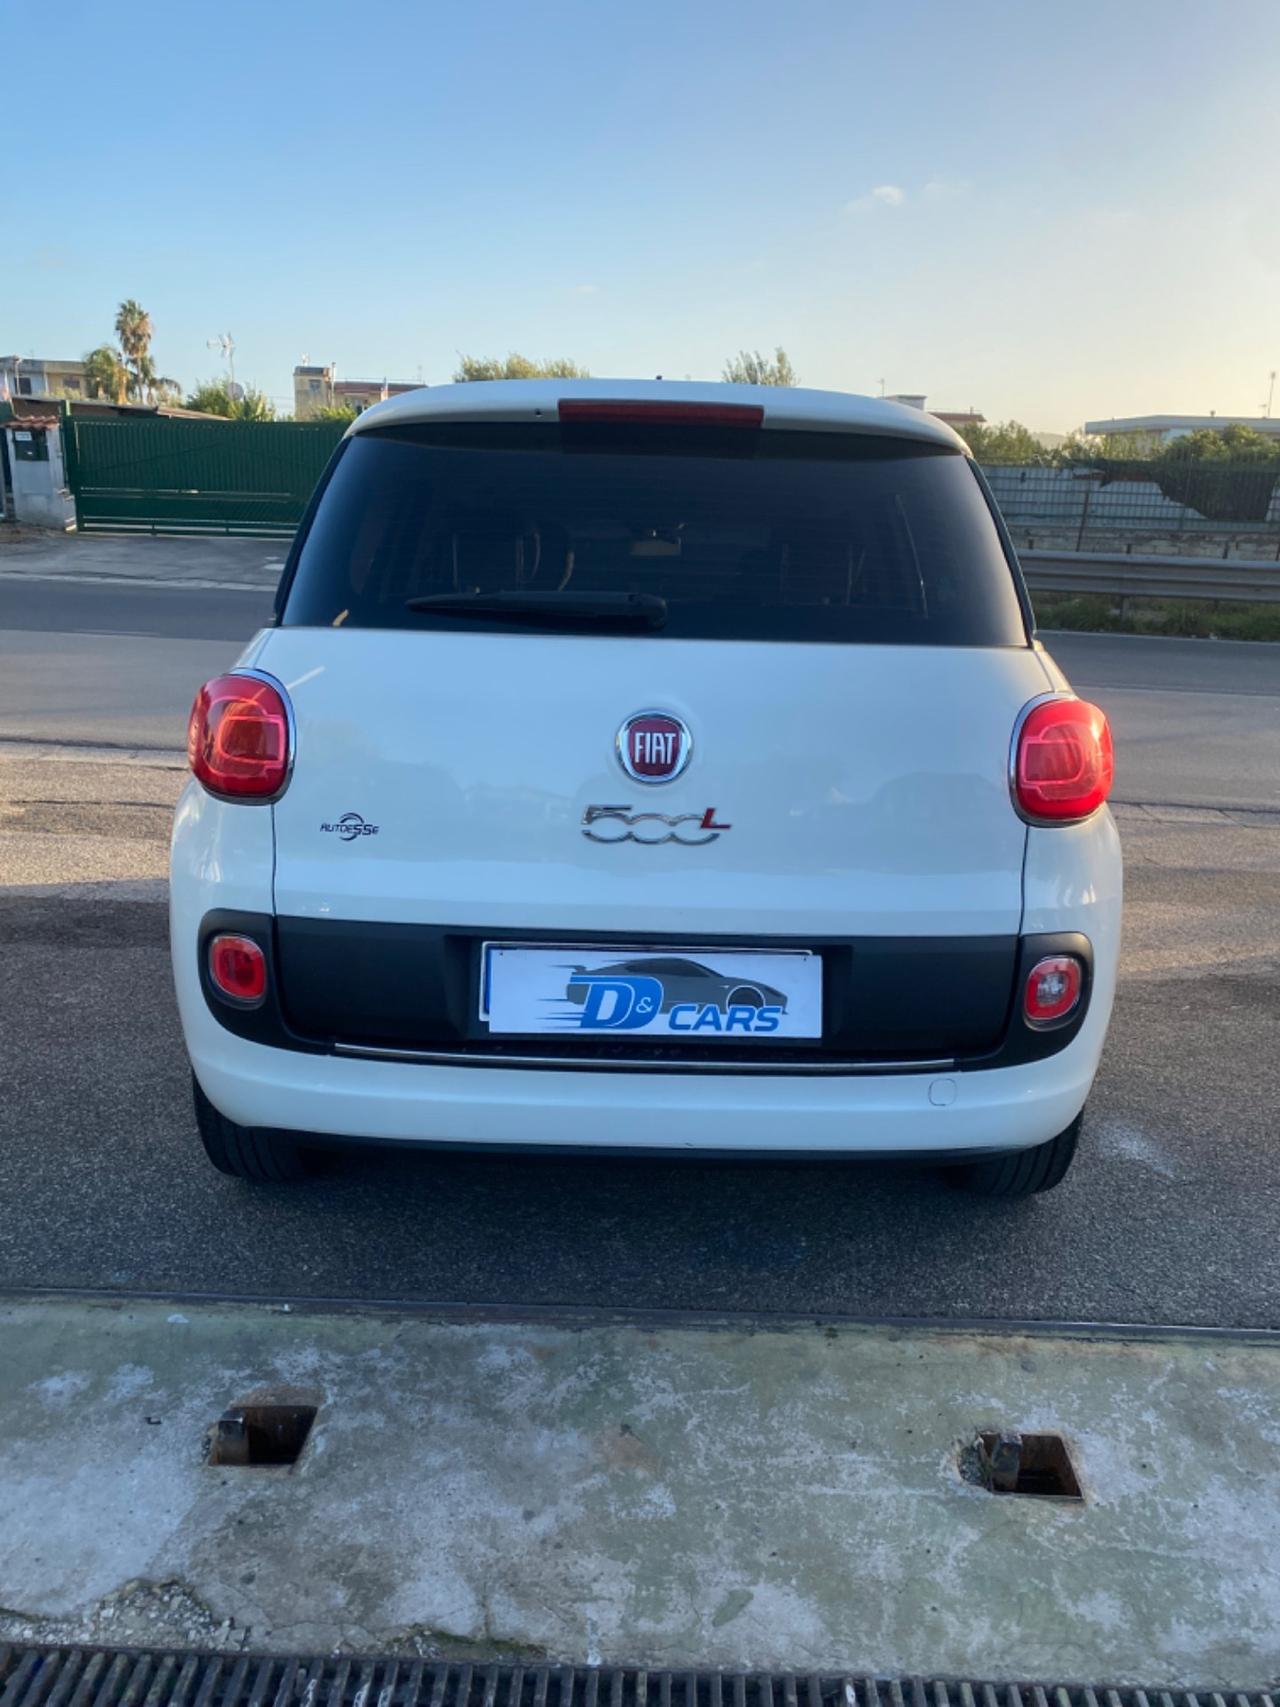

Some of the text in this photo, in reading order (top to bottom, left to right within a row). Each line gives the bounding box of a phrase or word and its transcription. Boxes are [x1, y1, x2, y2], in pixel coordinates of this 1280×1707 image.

[634, 732, 676, 764] FIAT
[581, 804, 732, 846] 500L
[668, 1003, 784, 1032] CARS
